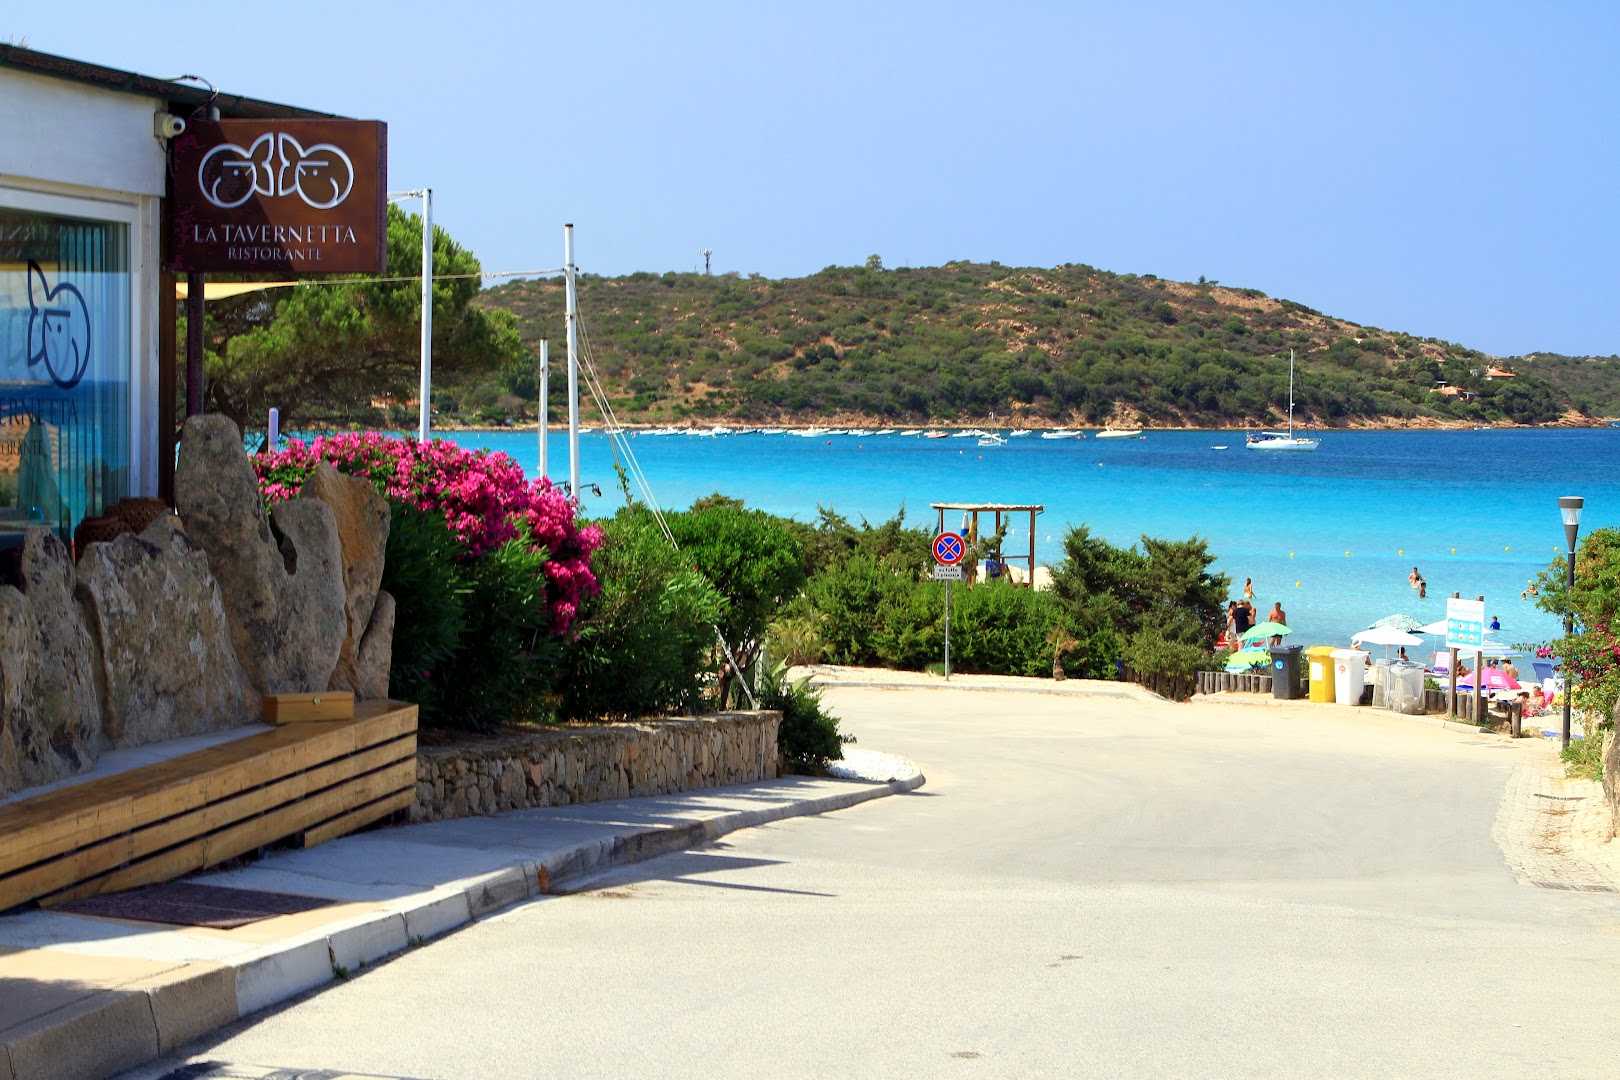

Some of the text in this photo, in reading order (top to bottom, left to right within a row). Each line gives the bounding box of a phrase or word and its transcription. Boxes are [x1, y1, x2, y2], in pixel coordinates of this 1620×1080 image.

[194, 224, 357, 244] LA TAVERNETTA
[228, 247, 322, 261] RISTORANTE
[0, 439, 43, 456] ORANTE
